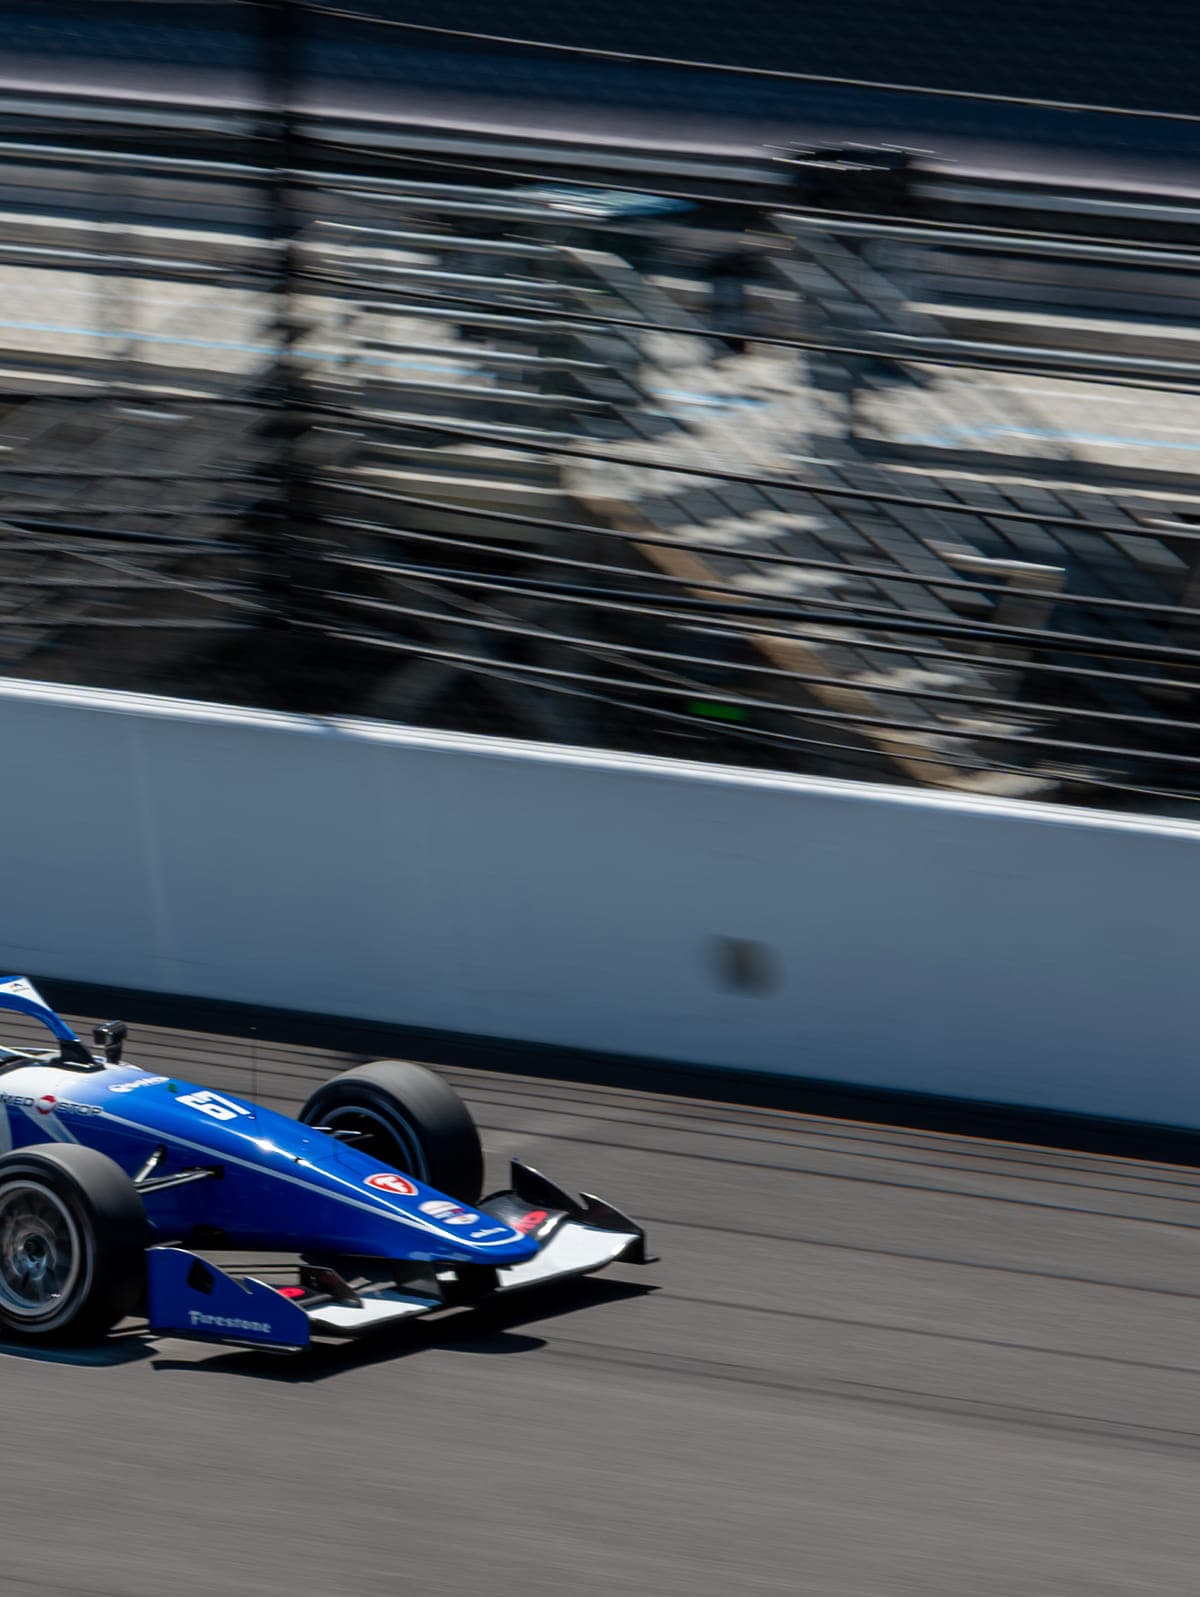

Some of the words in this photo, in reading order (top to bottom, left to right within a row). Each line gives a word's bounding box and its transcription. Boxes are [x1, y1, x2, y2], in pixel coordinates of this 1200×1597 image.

[56, 1101, 103, 1115] STOP
[175, 1090, 252, 1121] 67
[188, 1310, 272, 1333] Firestone
